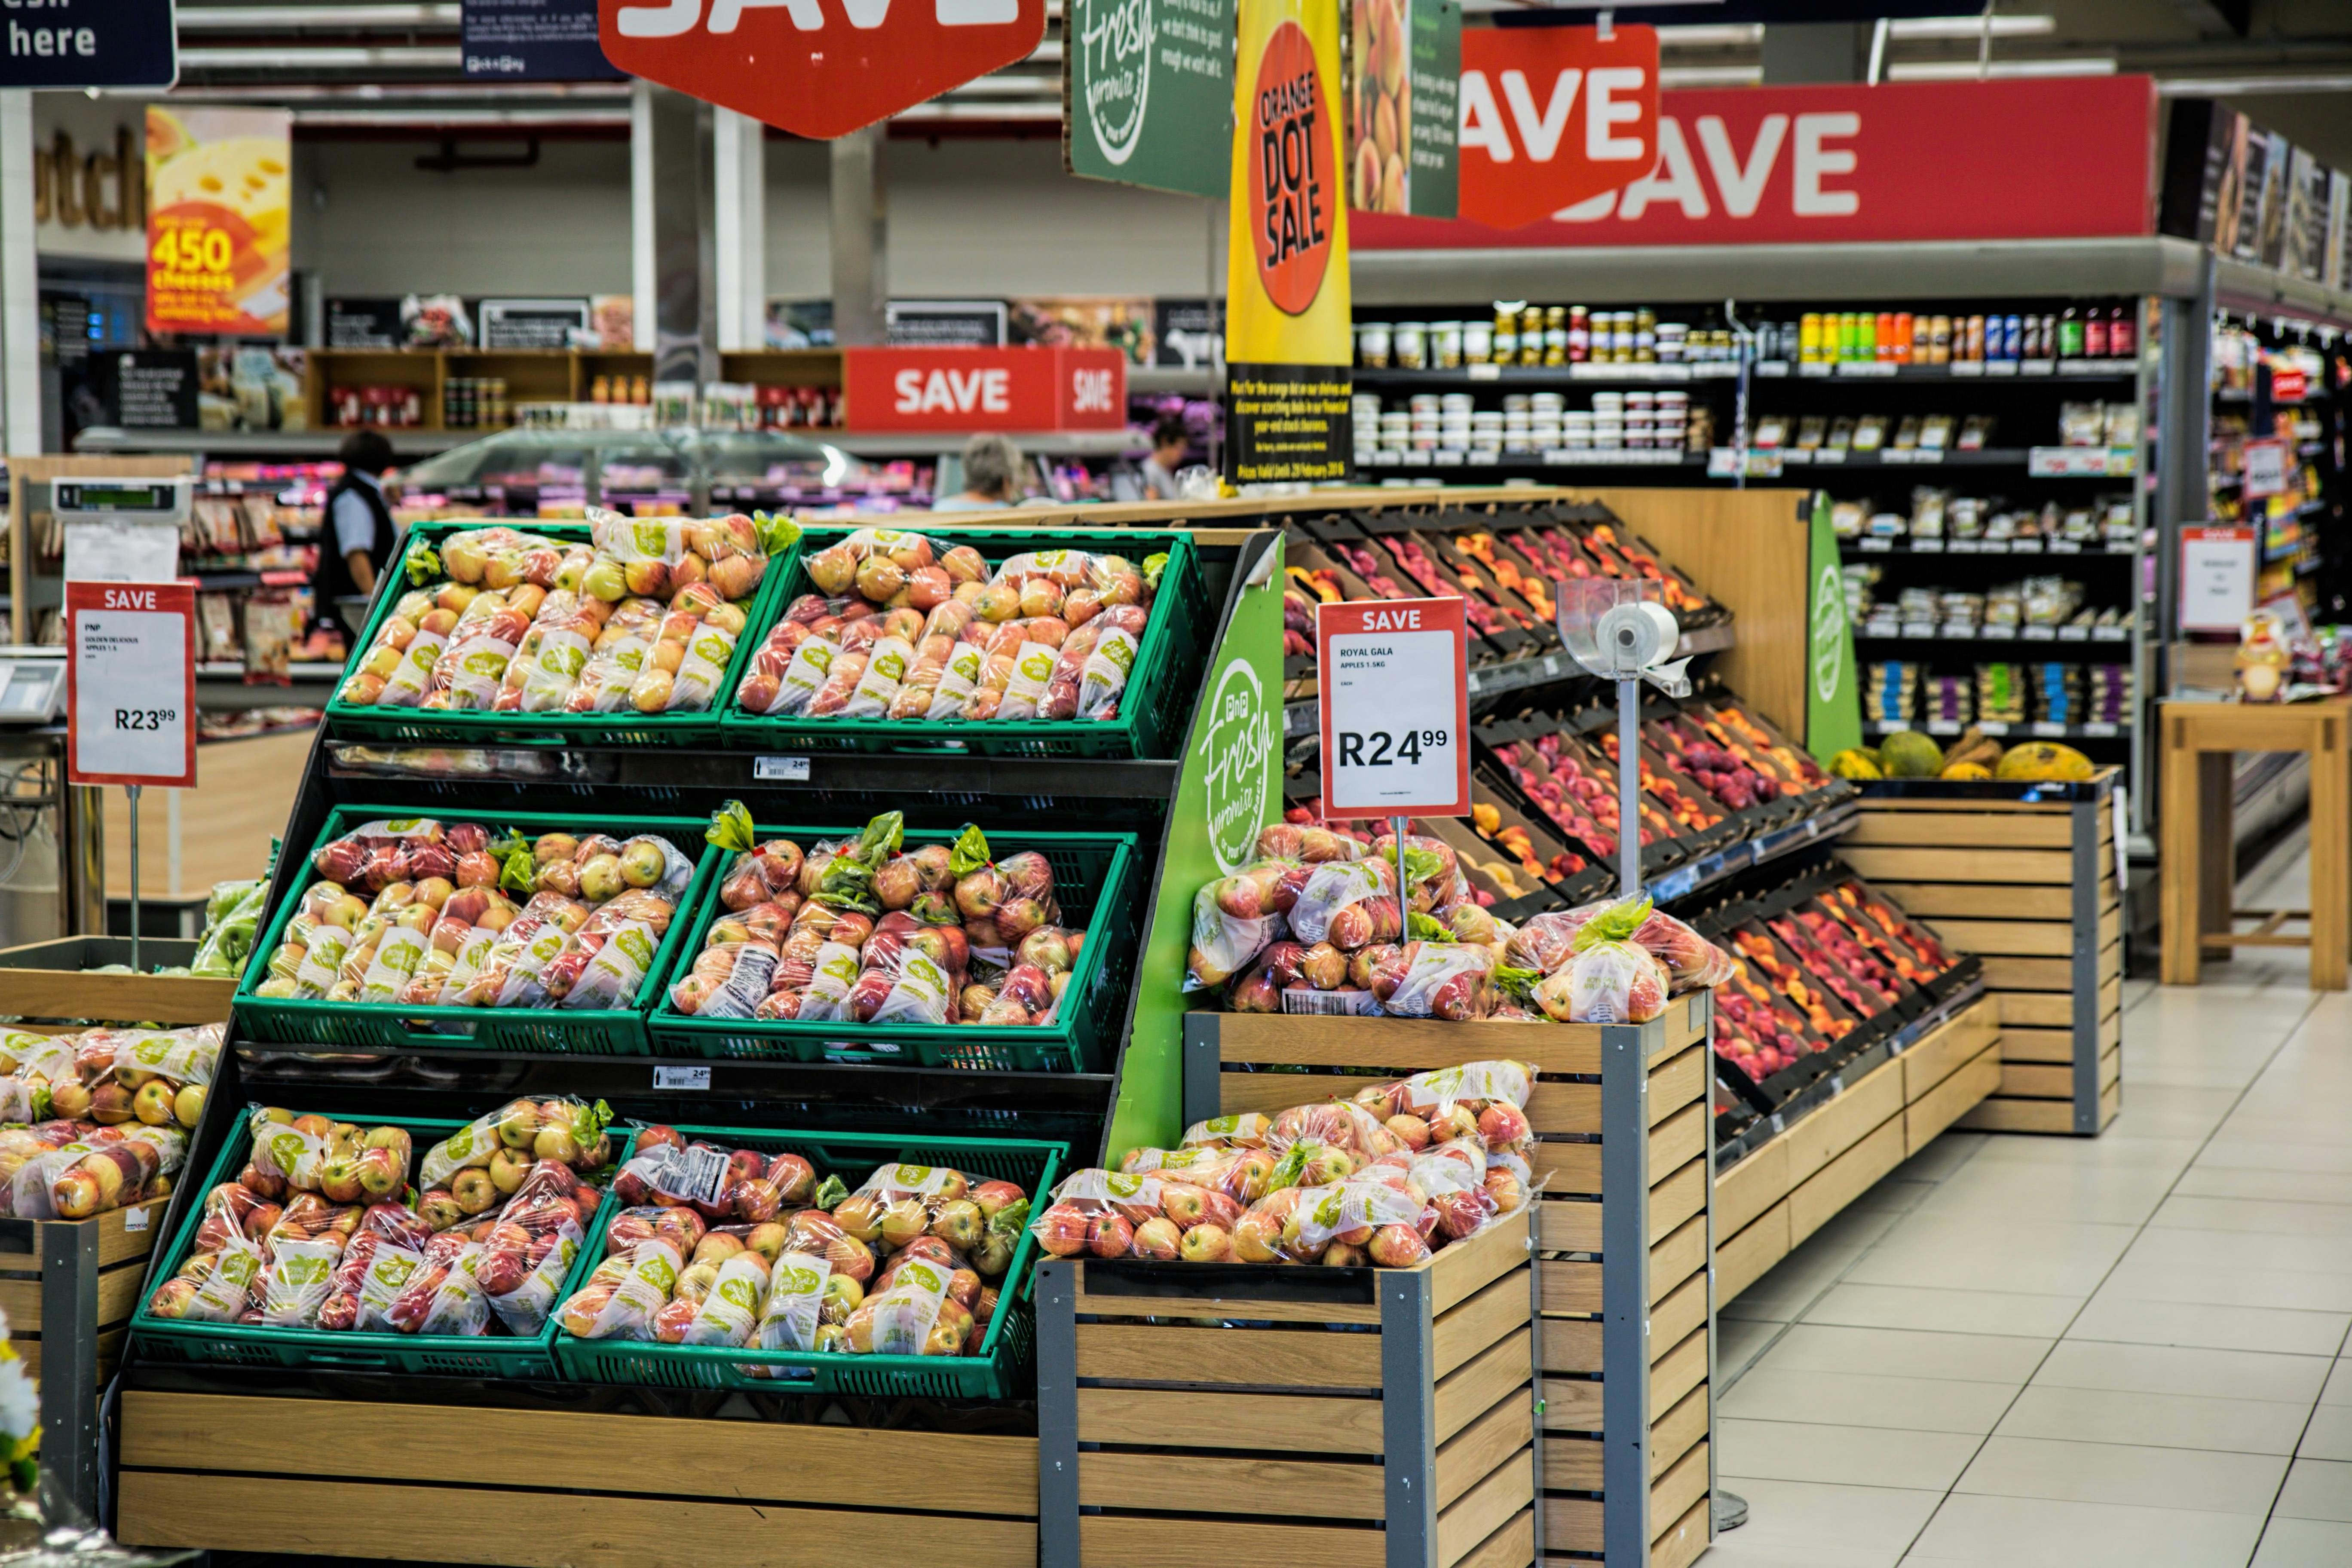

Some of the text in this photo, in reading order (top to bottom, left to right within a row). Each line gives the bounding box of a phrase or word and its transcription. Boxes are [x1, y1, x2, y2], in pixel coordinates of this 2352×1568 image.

[9, 19, 96, 56] here
[1259, 70, 1314, 129] ORANGE
[1459, 67, 1645, 162] AVE
[1261, 110, 1315, 206] DOT
[1550, 112, 1861, 223] AVE
[153, 227, 233, 271] 450
[1265, 182, 1324, 271] SALE
[895, 368, 1011, 413] SAVE
[104, 589, 156, 609] SAVE
[1362, 610, 1421, 631] SAVE
[1340, 647, 1393, 657] ROYAL GALA
[1199, 680, 1275, 800] Fresh
[1339, 730, 1447, 767] R2499
[1213, 787, 1253, 856] promise
[1227, 845, 1240, 860] your
[1253, 775, 1262, 815] back
[796, 1277, 816, 1286] GALA
